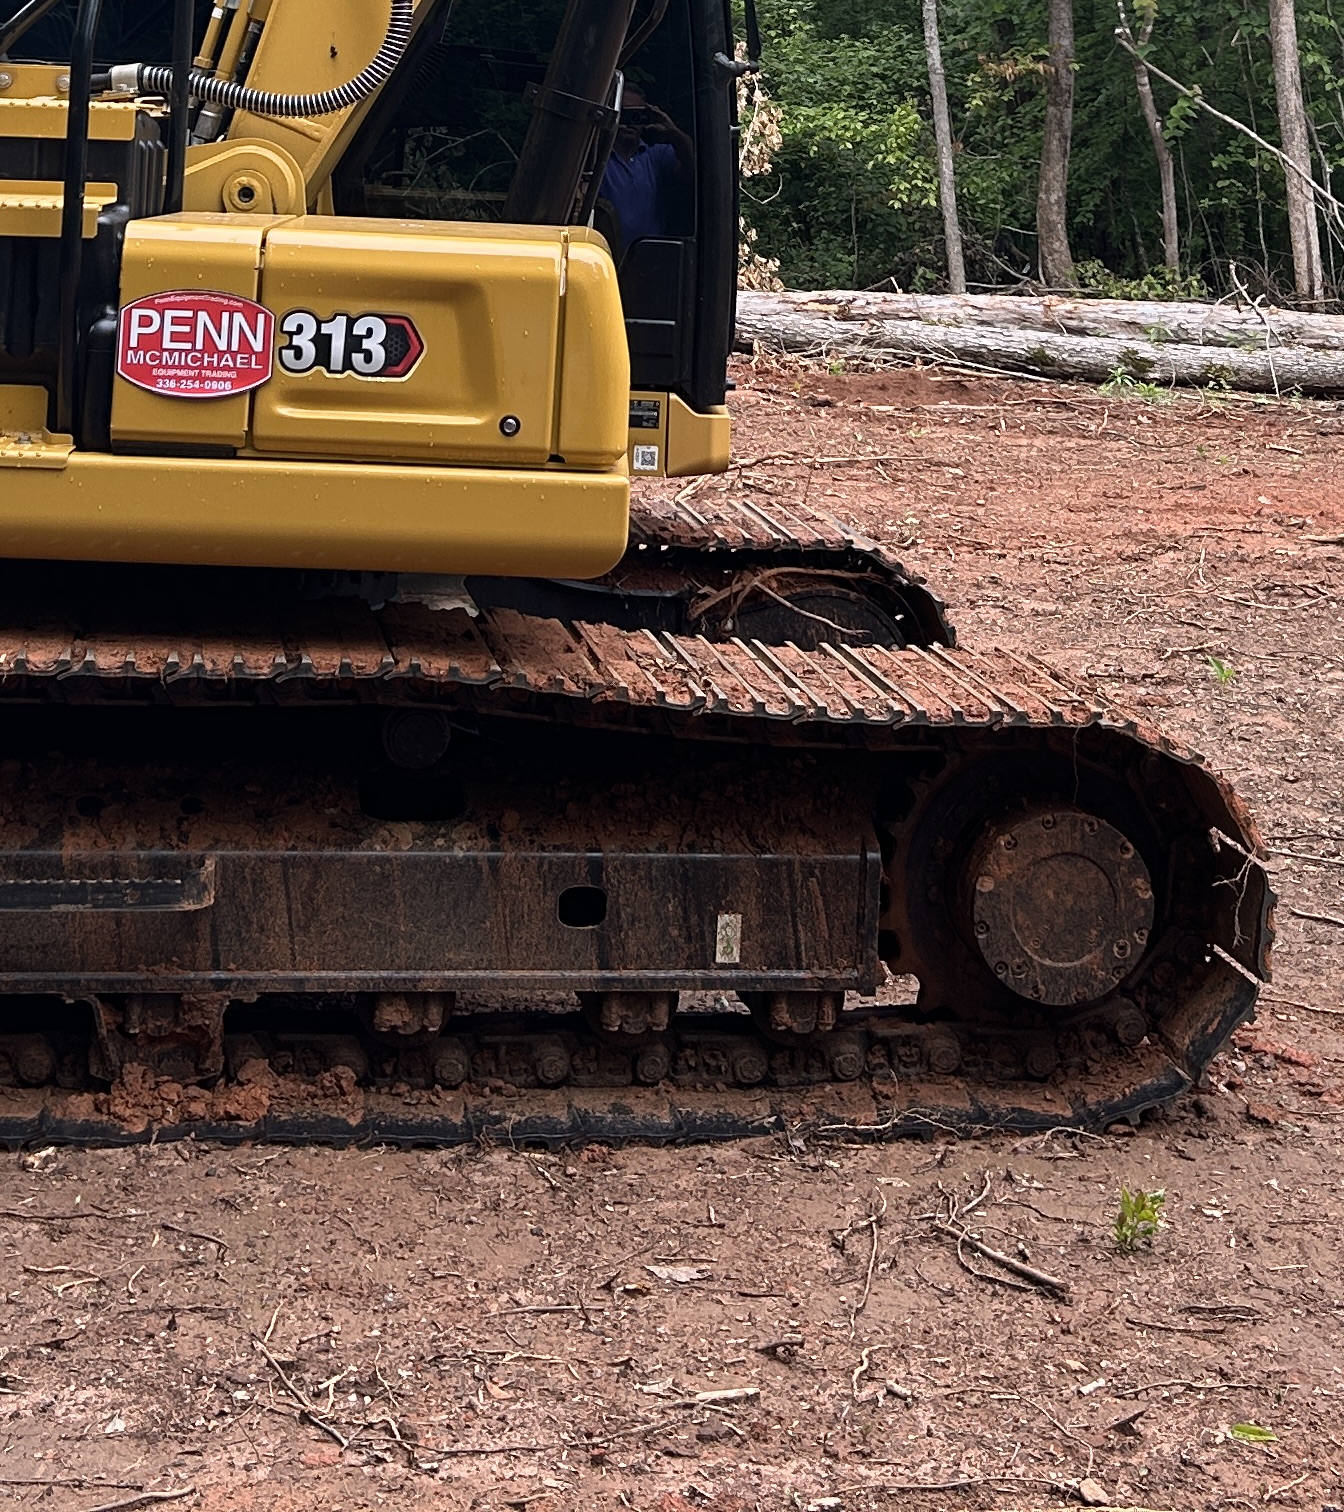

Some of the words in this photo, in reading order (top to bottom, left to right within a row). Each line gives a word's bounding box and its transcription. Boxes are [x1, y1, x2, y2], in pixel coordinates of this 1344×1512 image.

[129, 308, 265, 352] PENN
[281, 312, 387, 374] 313
[126, 349, 263, 369] MCMICHAEL
[152, 368, 199, 378] EQUIPMENT
[201, 369, 237, 378] TRADING
